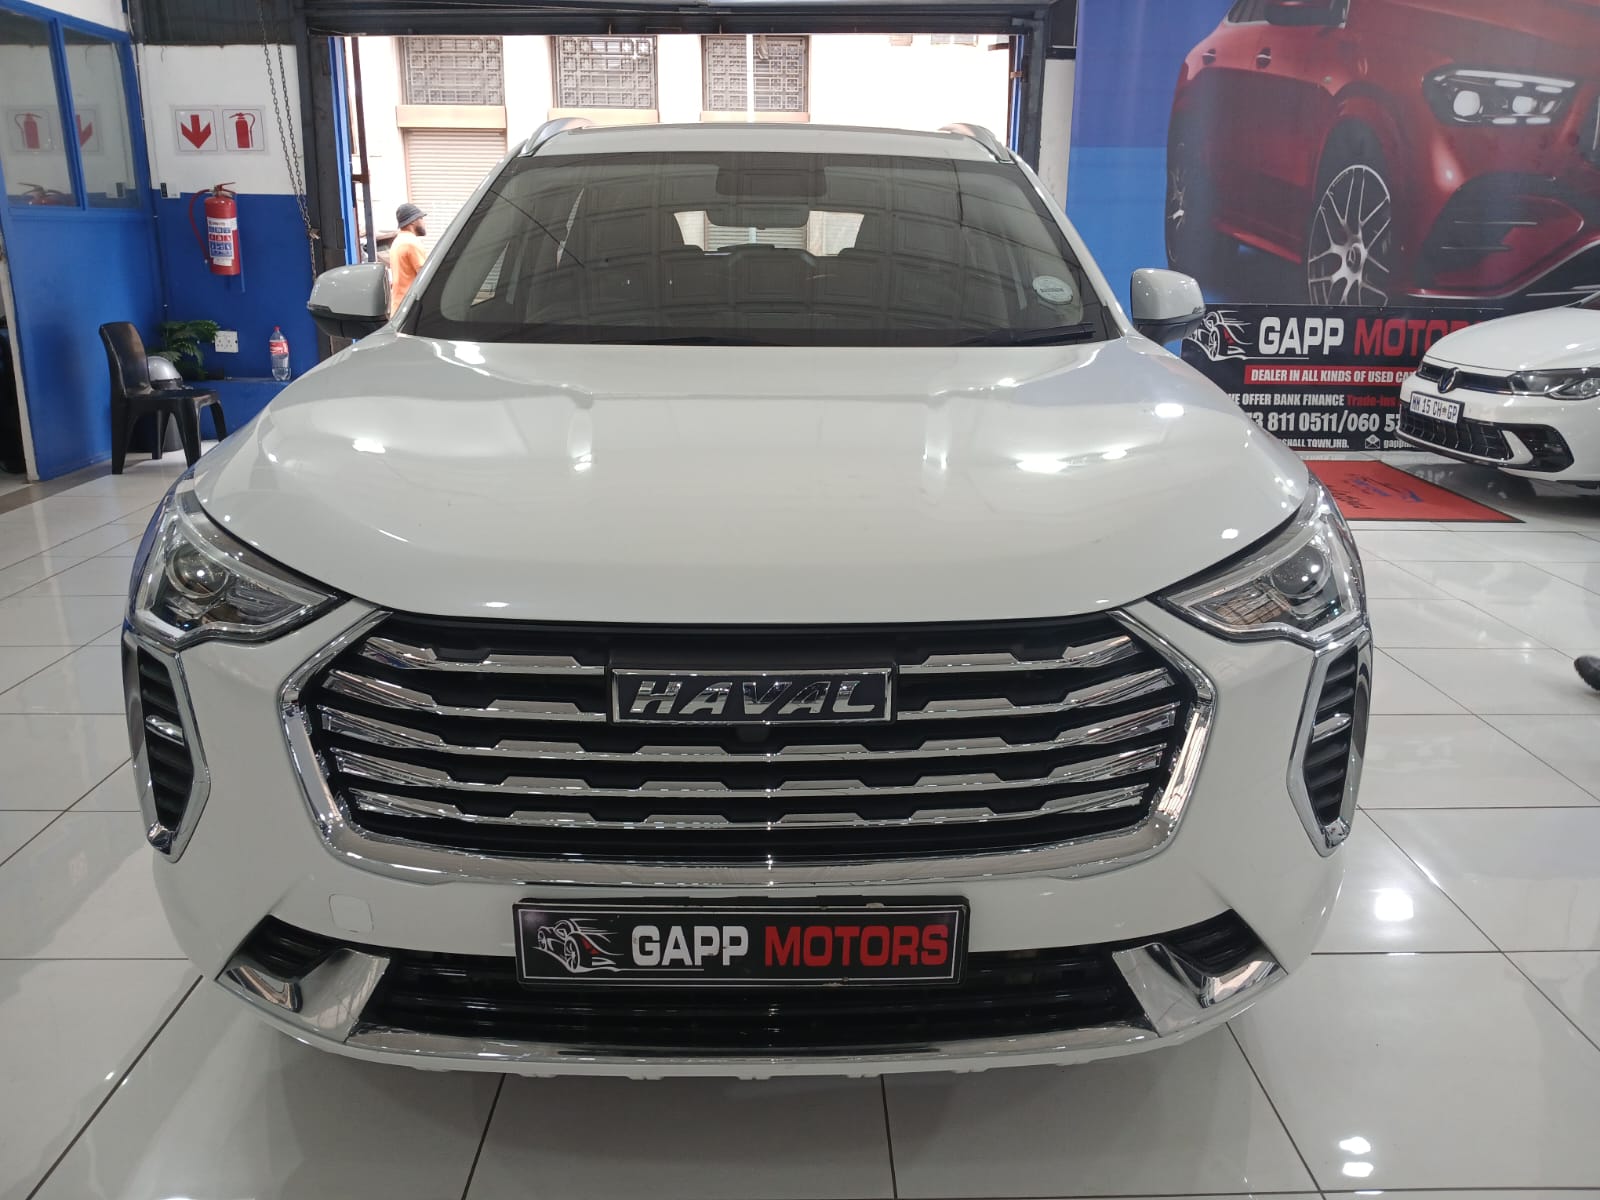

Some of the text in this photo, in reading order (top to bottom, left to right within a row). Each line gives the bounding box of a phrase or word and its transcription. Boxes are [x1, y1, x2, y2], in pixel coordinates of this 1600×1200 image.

[1258, 316, 1481, 356] GAPP MOTO
[1251, 369, 1287, 382] DEALER
[1289, 369, 1300, 382] IN
[1301, 370, 1318, 382] ALL
[1321, 370, 1352, 383] KINDS
[1354, 371, 1367, 383] OF
[1368, 371, 1394, 383] USED
[1242, 393, 1271, 406] OFFER
[1273, 393, 1301, 406] BANK
[1302, 394, 1345, 406] FINANCE
[1422, 398, 1432, 414] 15
[1433, 401, 1443, 417] CH
[1447, 404, 1458, 420] GP
[1267, 412, 1295, 431] 811
[1299, 410, 1380, 433] 0511/060
[629, 680, 876, 715] HAVAL
[631, 924, 949, 967] GAPP MOTORS
